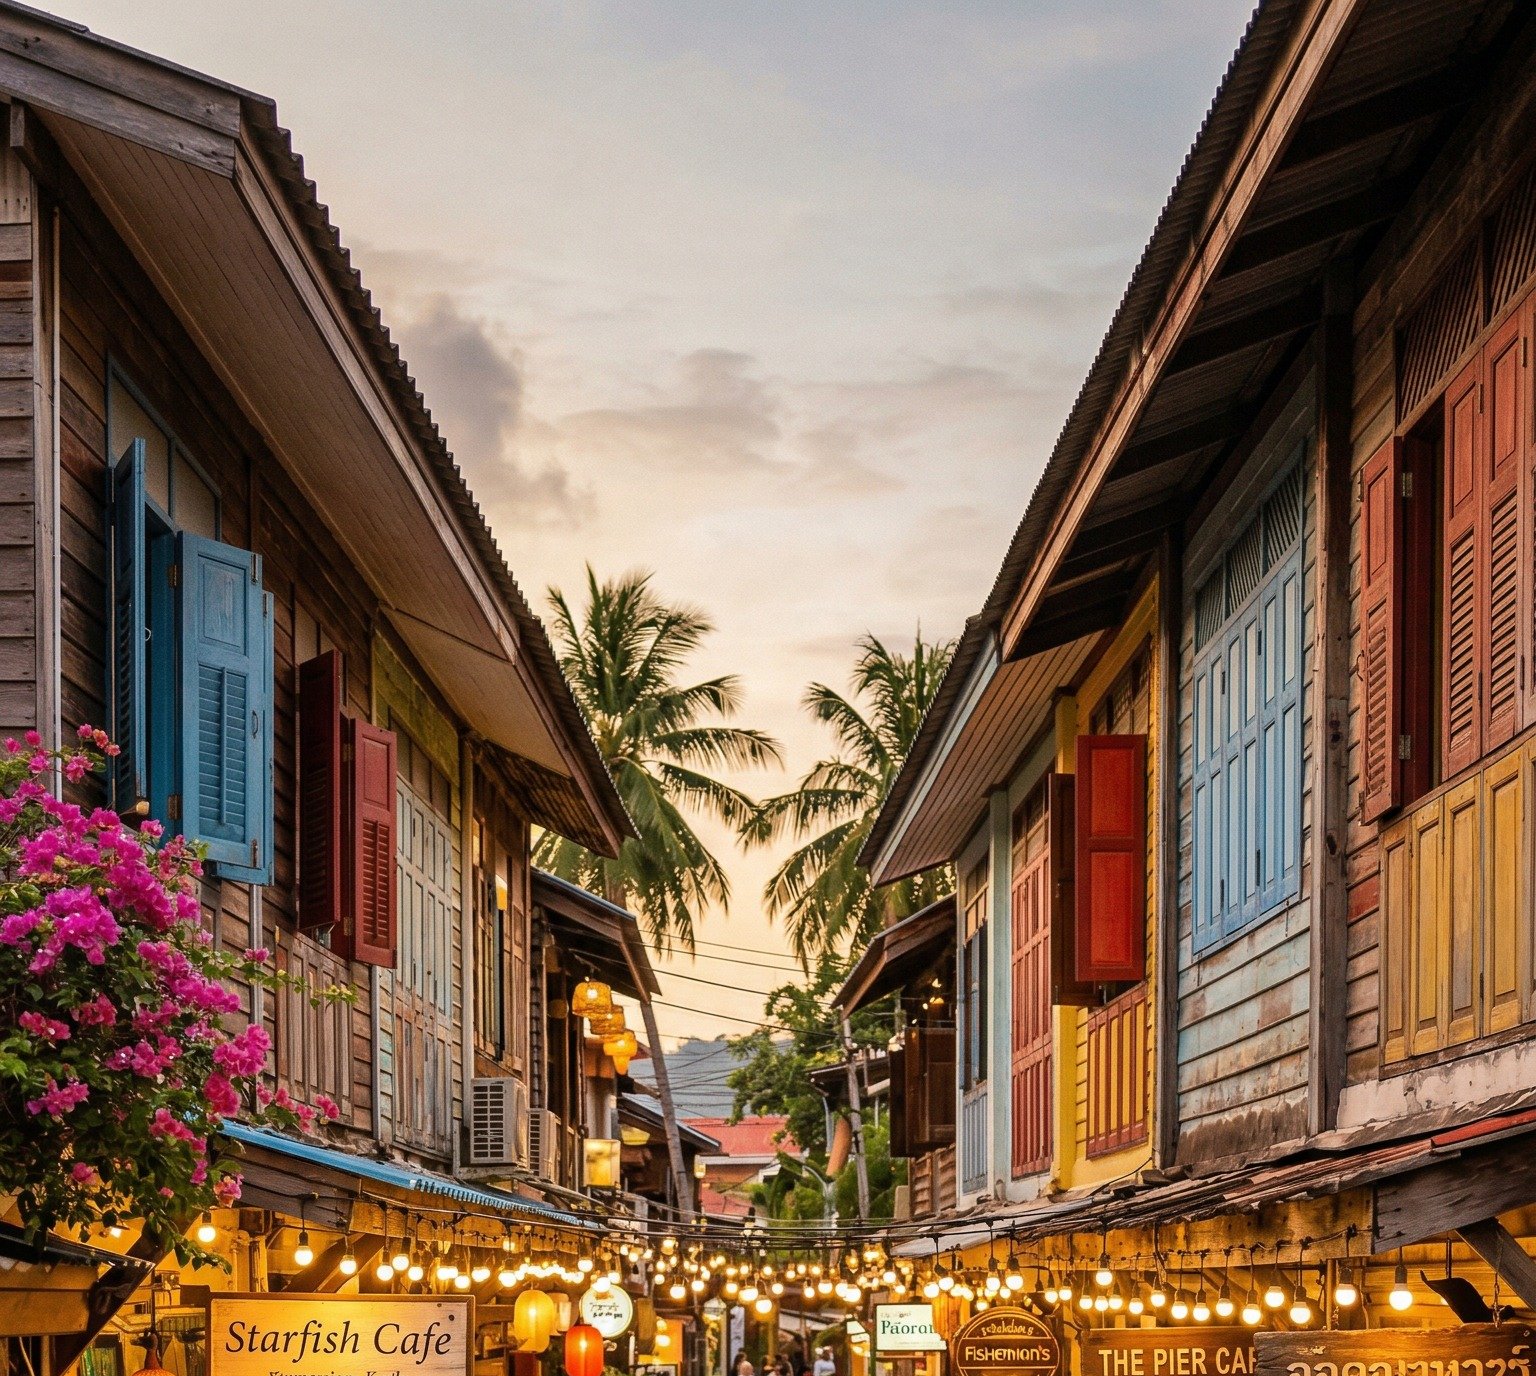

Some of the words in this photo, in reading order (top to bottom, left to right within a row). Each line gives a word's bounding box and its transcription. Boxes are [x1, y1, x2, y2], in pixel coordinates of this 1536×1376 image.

[225, 1319, 360, 1364] Starfish
[373, 1321, 452, 1365] Cafe
[1098, 1349, 1145, 1376] THE
[1153, 1347, 1208, 1376] PIER
